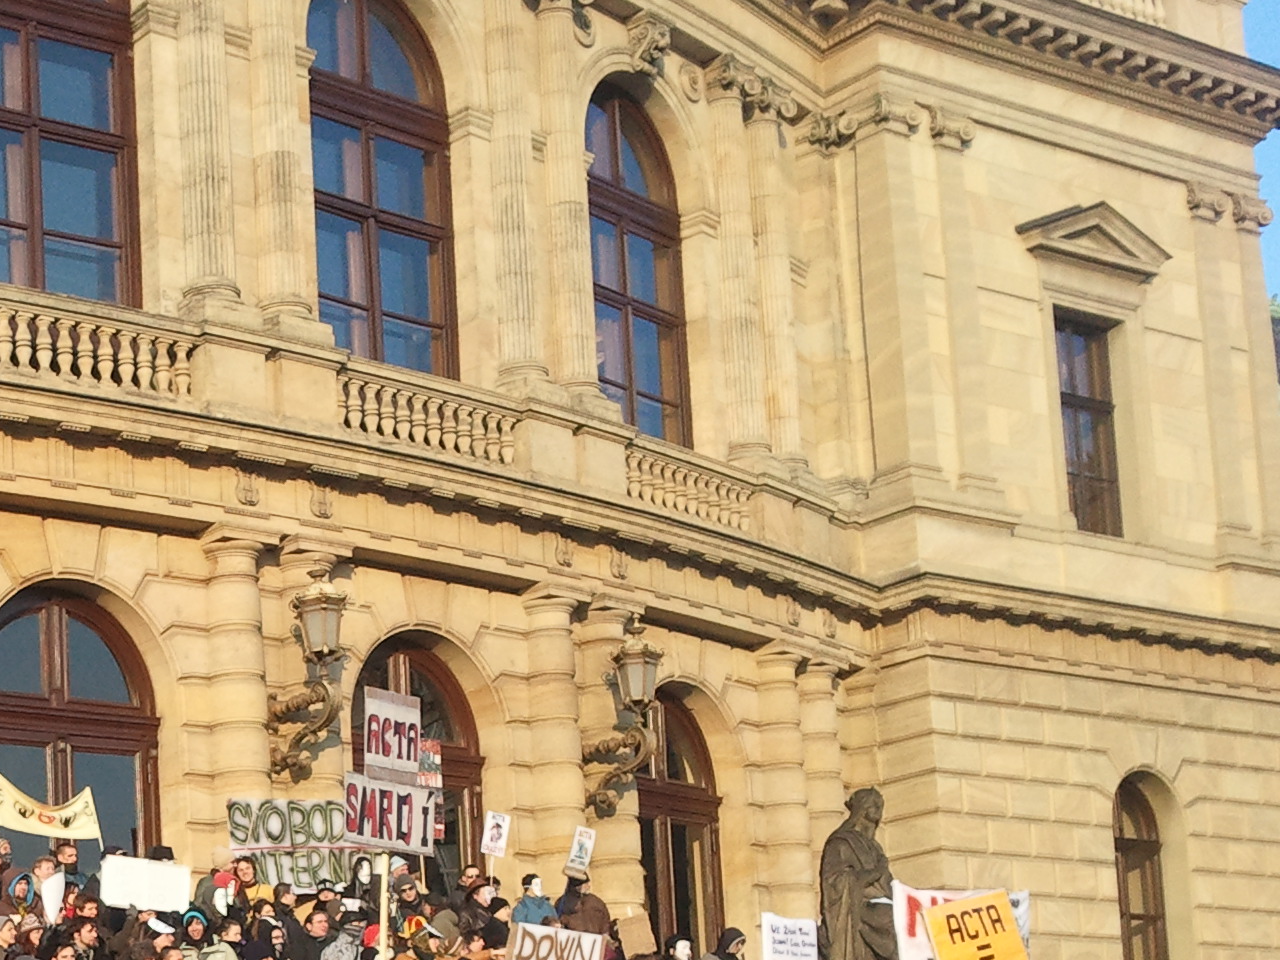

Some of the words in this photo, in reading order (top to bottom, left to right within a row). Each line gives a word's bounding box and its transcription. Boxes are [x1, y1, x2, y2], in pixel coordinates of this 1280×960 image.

[367, 713, 419, 762] ACTA
[229, 800, 344, 847] SVOBOD
[345, 783, 435, 848] SMRDÍ
[945, 904, 1006, 945] ACTA
